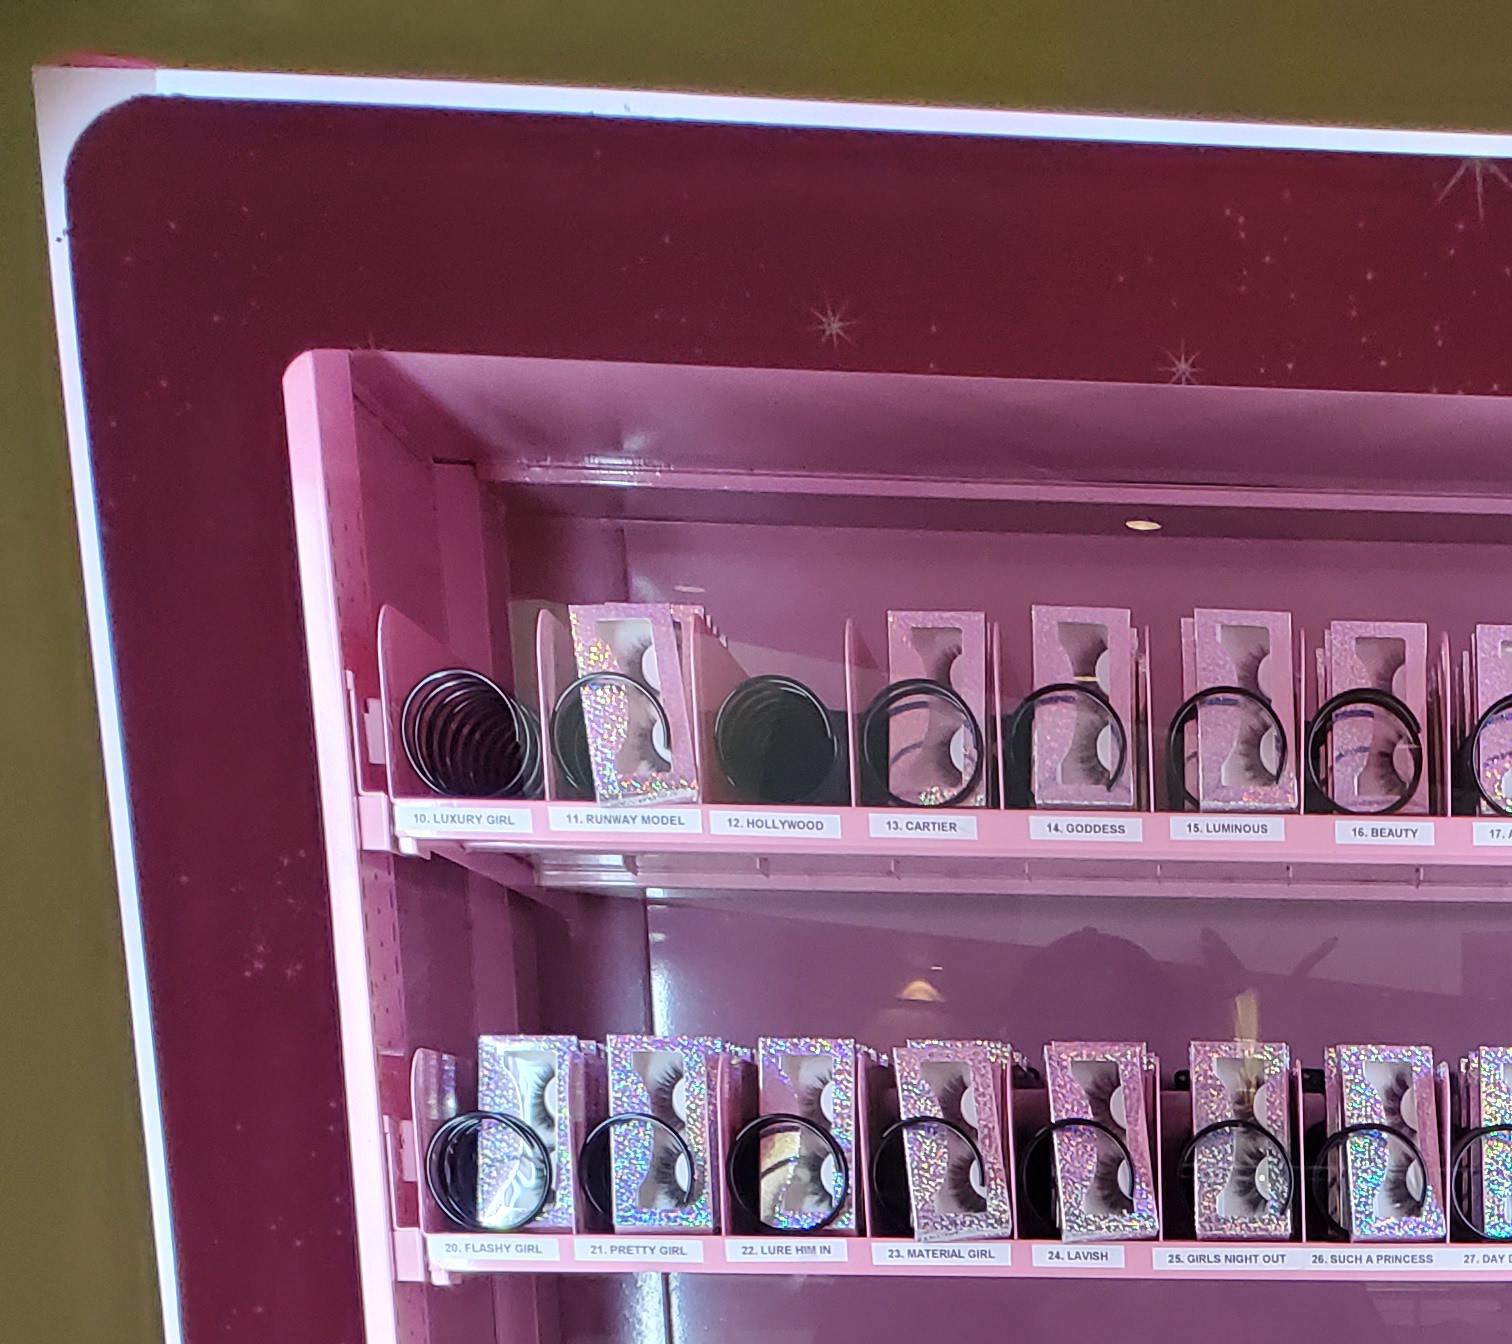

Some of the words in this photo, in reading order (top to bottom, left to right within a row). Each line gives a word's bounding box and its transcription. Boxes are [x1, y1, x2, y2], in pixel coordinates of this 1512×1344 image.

[414, 813, 430, 824] 10.
[433, 813, 482, 825] LUXURY
[487, 814, 515, 826] GIRL
[566, 813, 583, 824] 11.
[586, 814, 637, 825] RUNWAY
[641, 815, 685, 826] MODEL
[728, 817, 743, 828] 12.
[747, 818, 824, 831] HOLLYWOOD
[886, 820, 902, 831] 13.
[906, 821, 957, 832] CARTIER
[1047, 823, 1062, 833] 14.
[1067, 823, 1125, 834] GODDESS
[1187, 822, 1202, 833] 15.
[1206, 823, 1267, 834] LUMINOUS
[1352, 827, 1367, 838] 16.
[1371, 827, 1418, 838] BEAUTY
[1490, 828, 1505, 839] 17.
[445, 1242, 461, 1253] 20.
[465, 1243, 511, 1253] FLASHY
[515, 1243, 542, 1254] GIRL
[590, 1244, 607, 1255] 21.
[610, 1245, 653, 1255] PRETTY
[655, 1245, 687, 1256] GIRL
[742, 1245, 757, 1256] 22.
[761, 1245, 792, 1256] LURE
[795, 1245, 816, 1255] HIM
[820, 1244, 831, 1255] IN
[888, 1248, 904, 1259] 23.
[908, 1248, 961, 1259] MATERIAL
[962, 1249, 995, 1259] GIRL
[1048, 1250, 1064, 1261] 24.
[1067, 1251, 1108, 1261] LAVISH
[1168, 1253, 1184, 1264] 25.
[1187, 1254, 1221, 1264] GIRLS
[1225, 1254, 1259, 1264] NIGHT
[1263, 1253, 1286, 1264] OUT
[1312, 1254, 1327, 1264] 26.
[1330, 1254, 1359, 1264] SUCH
[1376, 1254, 1433, 1264] PRINCESS
[1464, 1253, 1479, 1264] 27.
[1483, 1253, 1505, 1264] DAY
